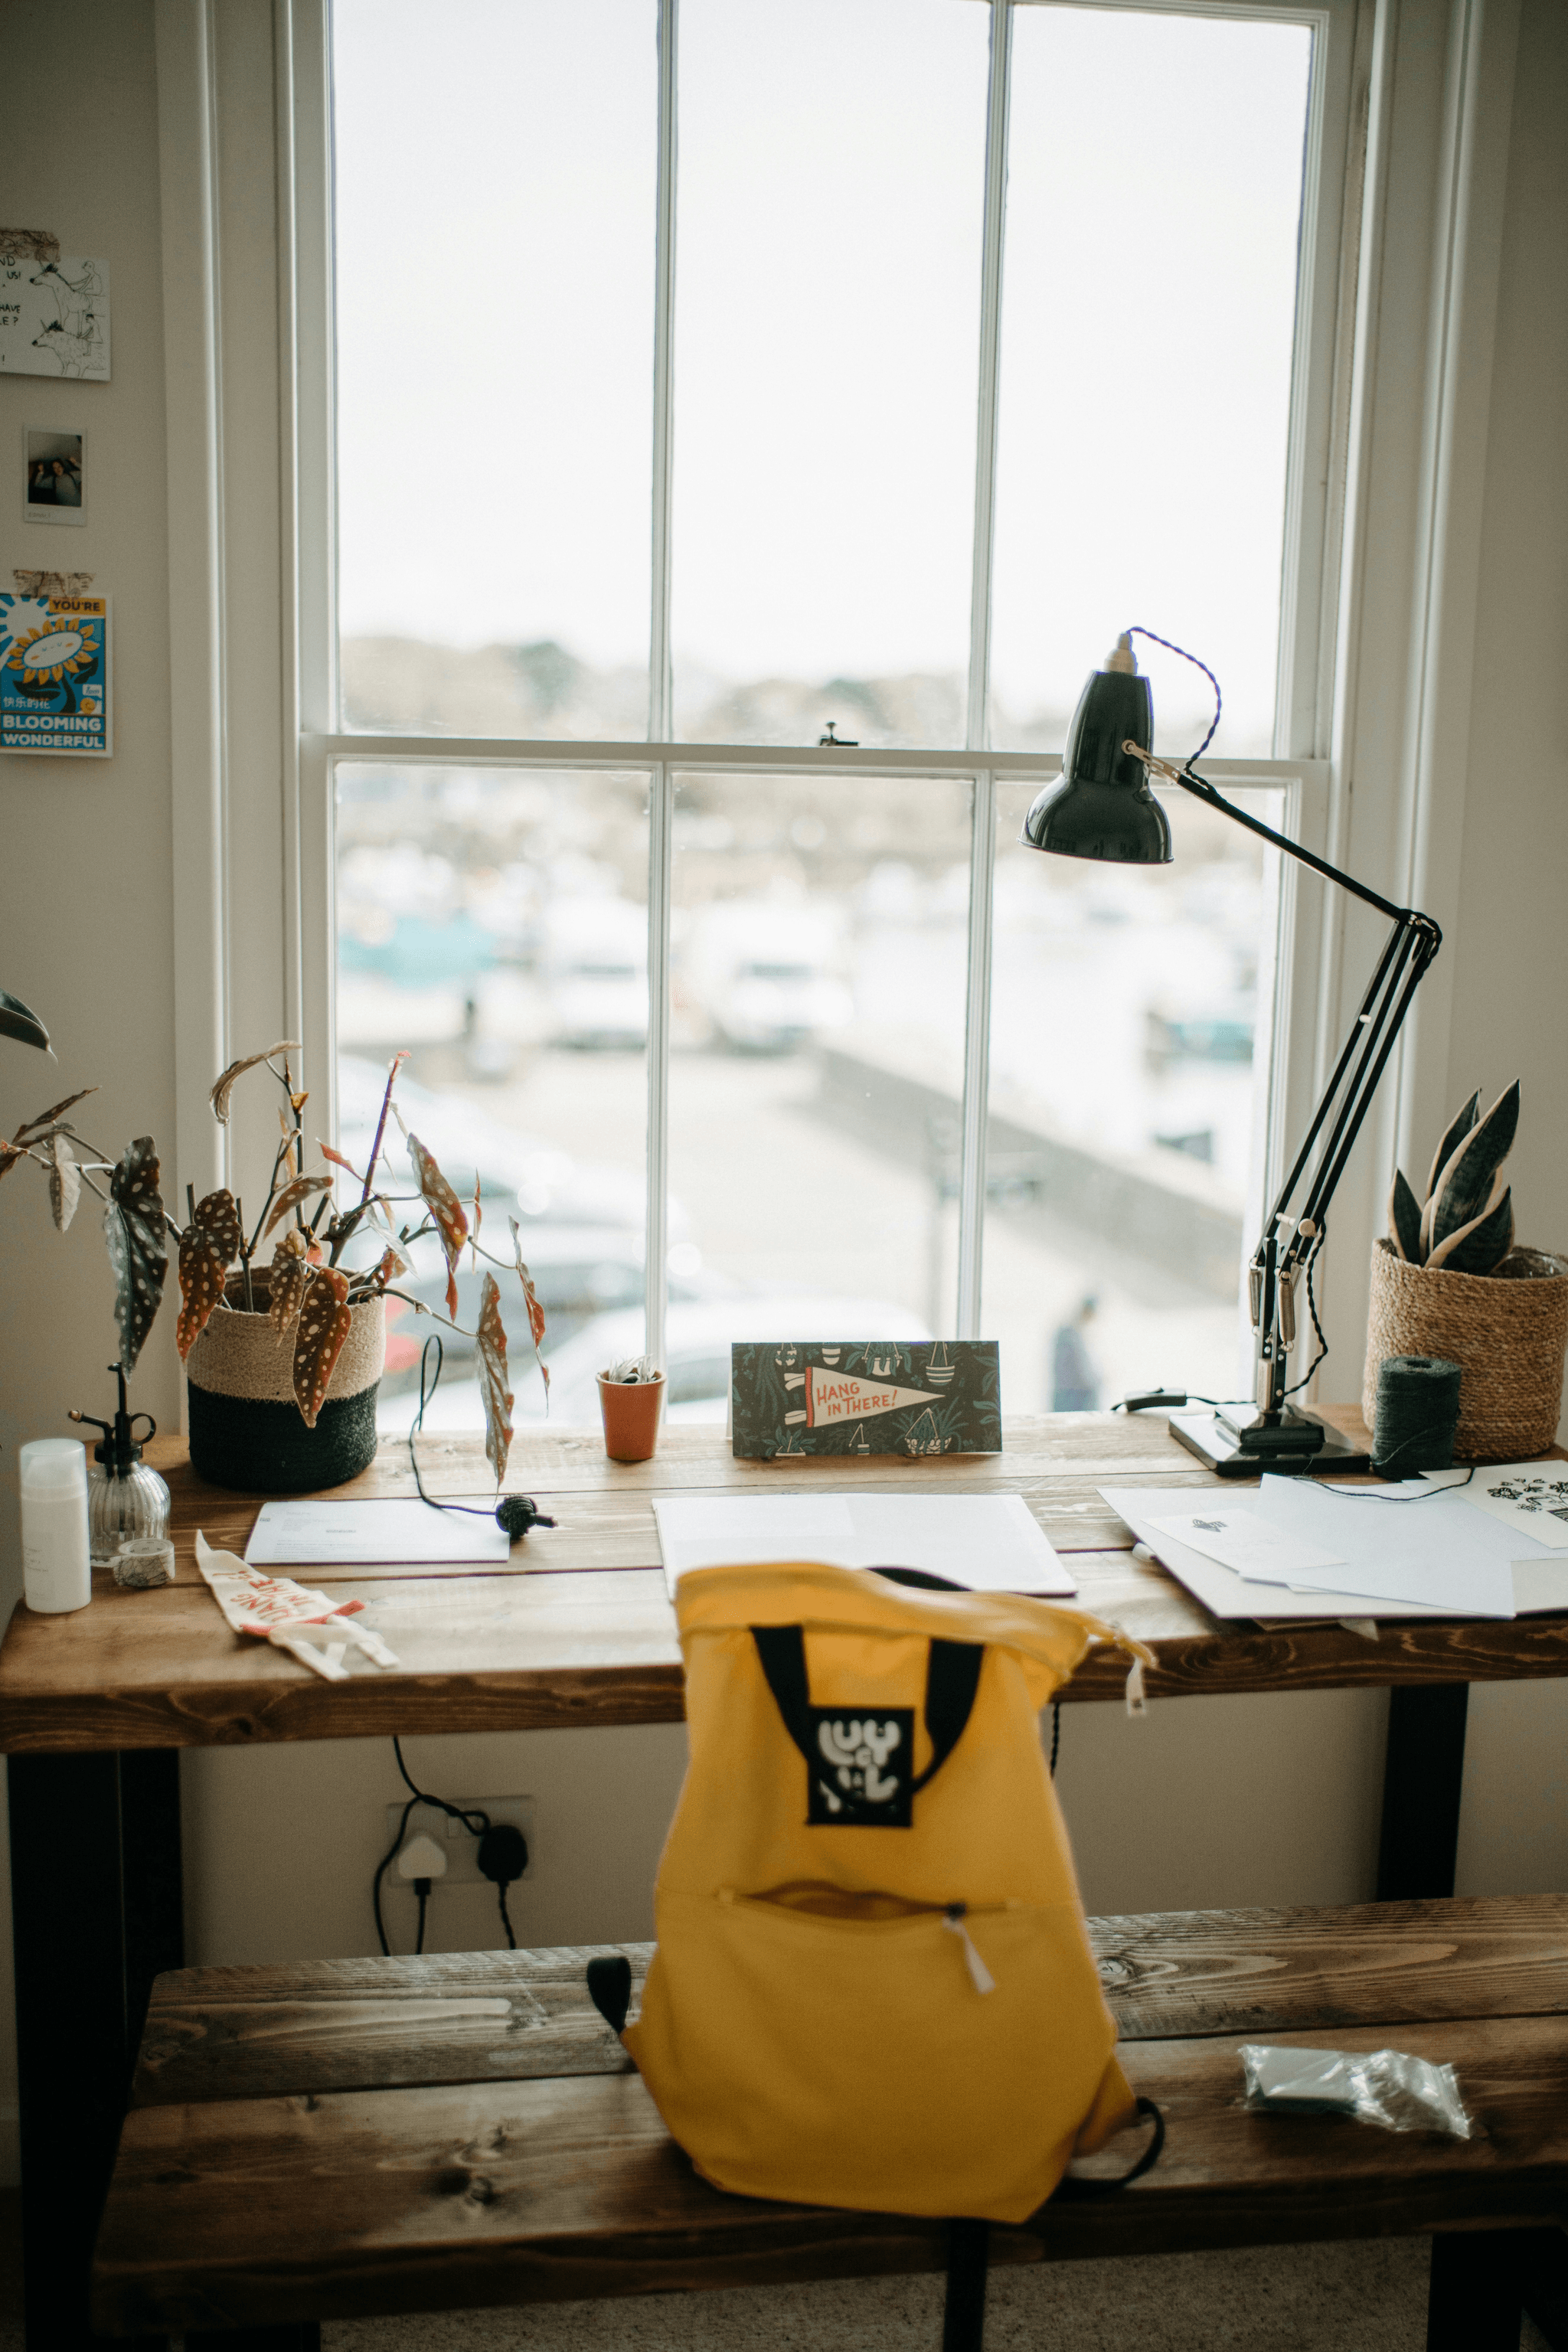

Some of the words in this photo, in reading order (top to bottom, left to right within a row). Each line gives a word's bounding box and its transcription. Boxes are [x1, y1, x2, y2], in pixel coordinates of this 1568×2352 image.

[7, 270, 21, 280] US!
[53, 600, 100, 612] YOU'RE
[3, 715, 101, 731] BLOOMING
[4, 733, 103, 747] WONDERFUL
[817, 1382, 860, 1406] HANG
[828, 1403, 841, 1416] IN
[842, 1389, 897, 1414] THERE!
